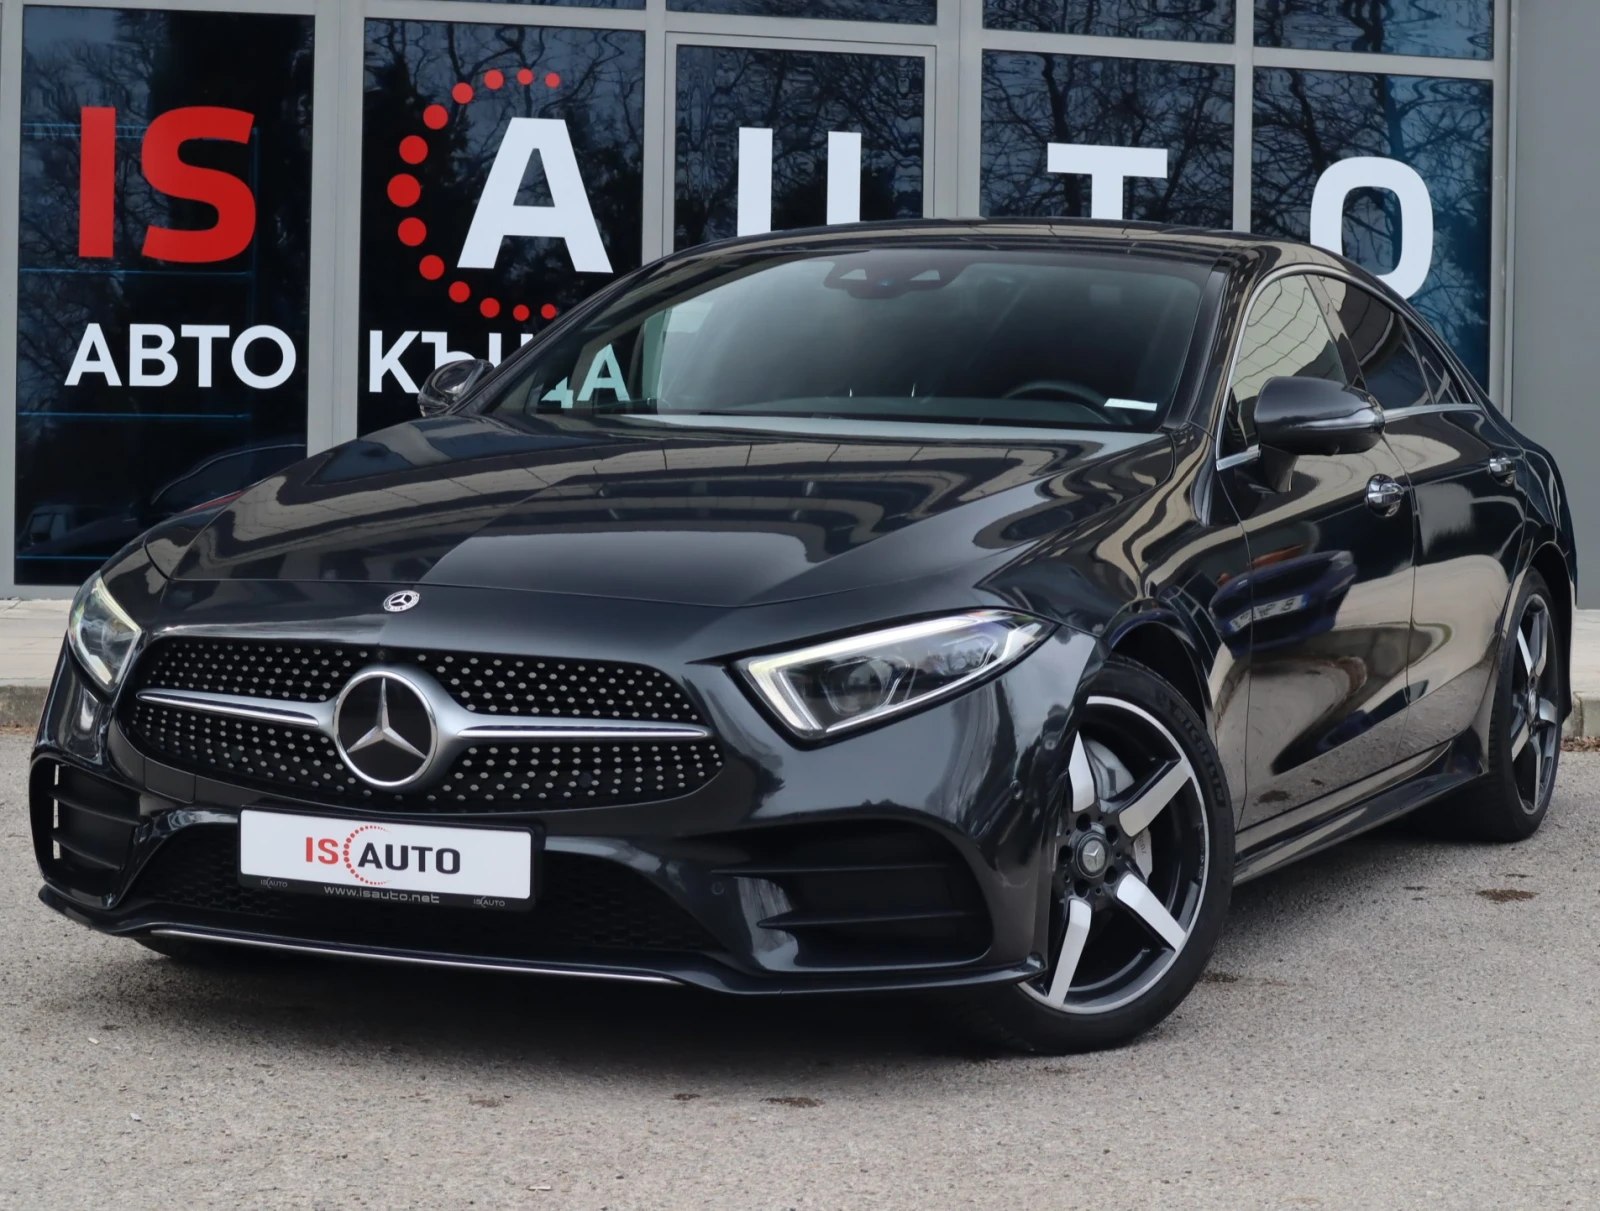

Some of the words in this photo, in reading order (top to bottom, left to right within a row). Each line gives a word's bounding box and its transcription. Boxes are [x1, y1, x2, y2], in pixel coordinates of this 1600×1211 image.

[78, 106, 256, 263] IS
[64, 323, 297, 390] АВТО
[1171, 703, 1225, 804] MICHELIN
[305, 836, 339, 865] IS
[357, 841, 461, 875] AUTO
[323, 885, 440, 904] www.isauto.net
